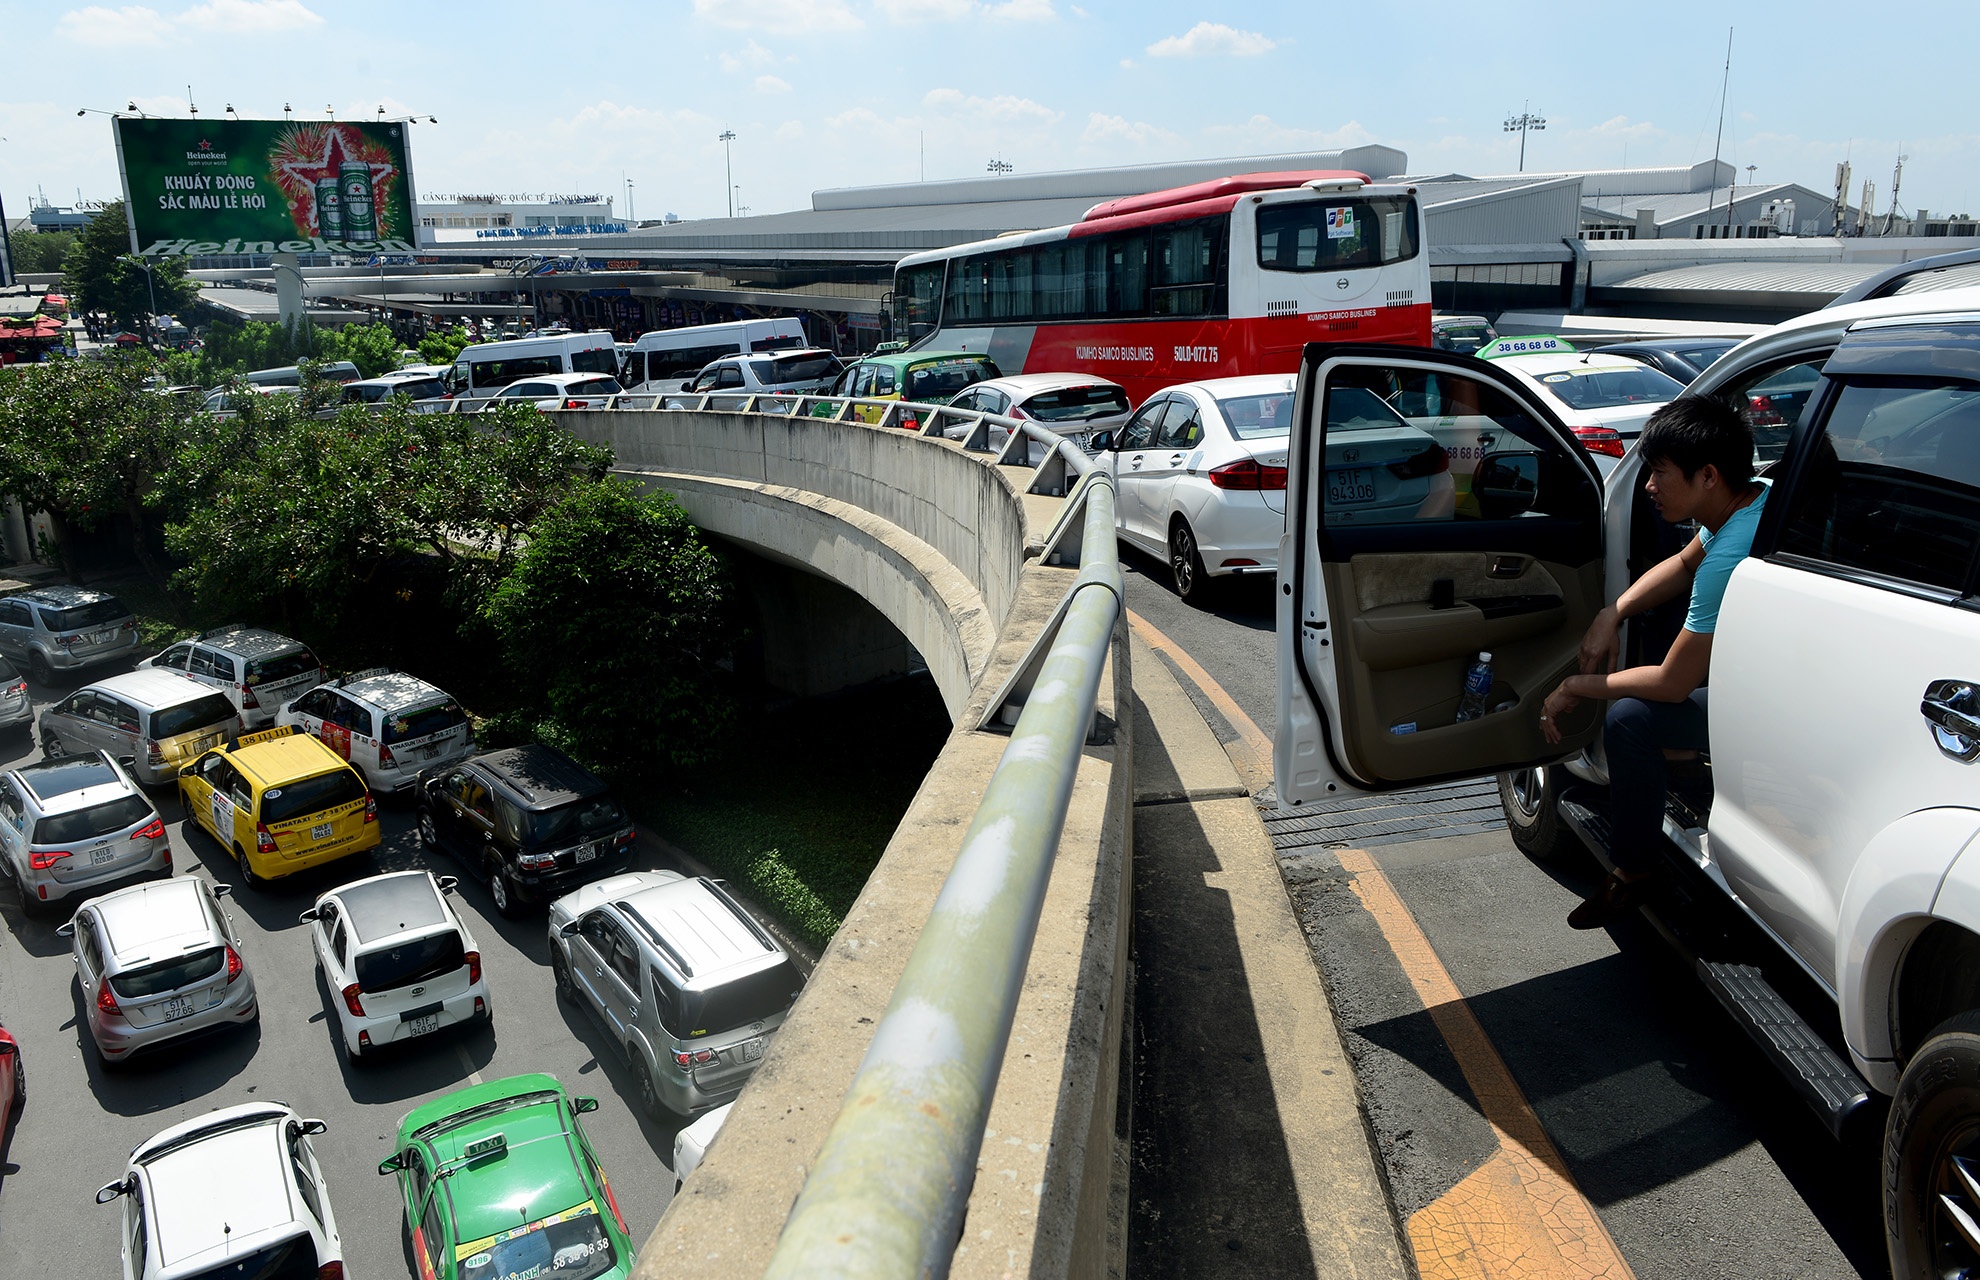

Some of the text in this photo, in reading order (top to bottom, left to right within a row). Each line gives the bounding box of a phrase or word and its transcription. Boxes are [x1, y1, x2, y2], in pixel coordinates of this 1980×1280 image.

[164, 172, 255, 192] KHUẤY ĐỘNG
[159, 191, 265, 210] SẮC MÀU LỄ HỘI
[423, 192, 447, 201] CẢNG
[450, 192, 474, 201] HÀNG
[509, 192, 532, 202] QUỐC
[535, 192, 545, 201] TẾ
[1328, 211, 1352, 225] FPT
[140, 238, 417, 256] Heineken
[607, 260, 641, 270] GROUP
[1329, 311, 1349, 319] SAMCO
[1350, 309, 1376, 318] BUSLINES
[1498, 340, 1557, 352] 38 68 68 68
[1076, 346, 1154, 361] KUMHO SAMCO BUSLINES
[1460, 447, 1471, 459] 68
[1474, 447, 1485, 459] 68
[1338, 471, 1361, 486] 51F
[1332, 485, 1373, 500] 943.06
[242, 727, 290, 746] 38 111 111
[272, 816, 311, 830] VINATAXI
[341, 804, 352, 812] 111
[354, 800, 365, 808] 111
[295, 835, 354, 856] www.vinataxi.vn
[169, 999, 185, 1010] 51A
[165, 1005, 193, 1019] 577.65
[416, 1016, 430, 1027] 51F
[474, 1139, 498, 1153] TAXI
[1886, 1057, 1957, 1239] DUELER
[468, 1255, 488, 1267] 9196
[553, 1256, 566, 1271] 38
[568, 1250, 581, 1264] 38
[583, 1243, 595, 1257] 38
[597, 1238, 609, 1251] 38
